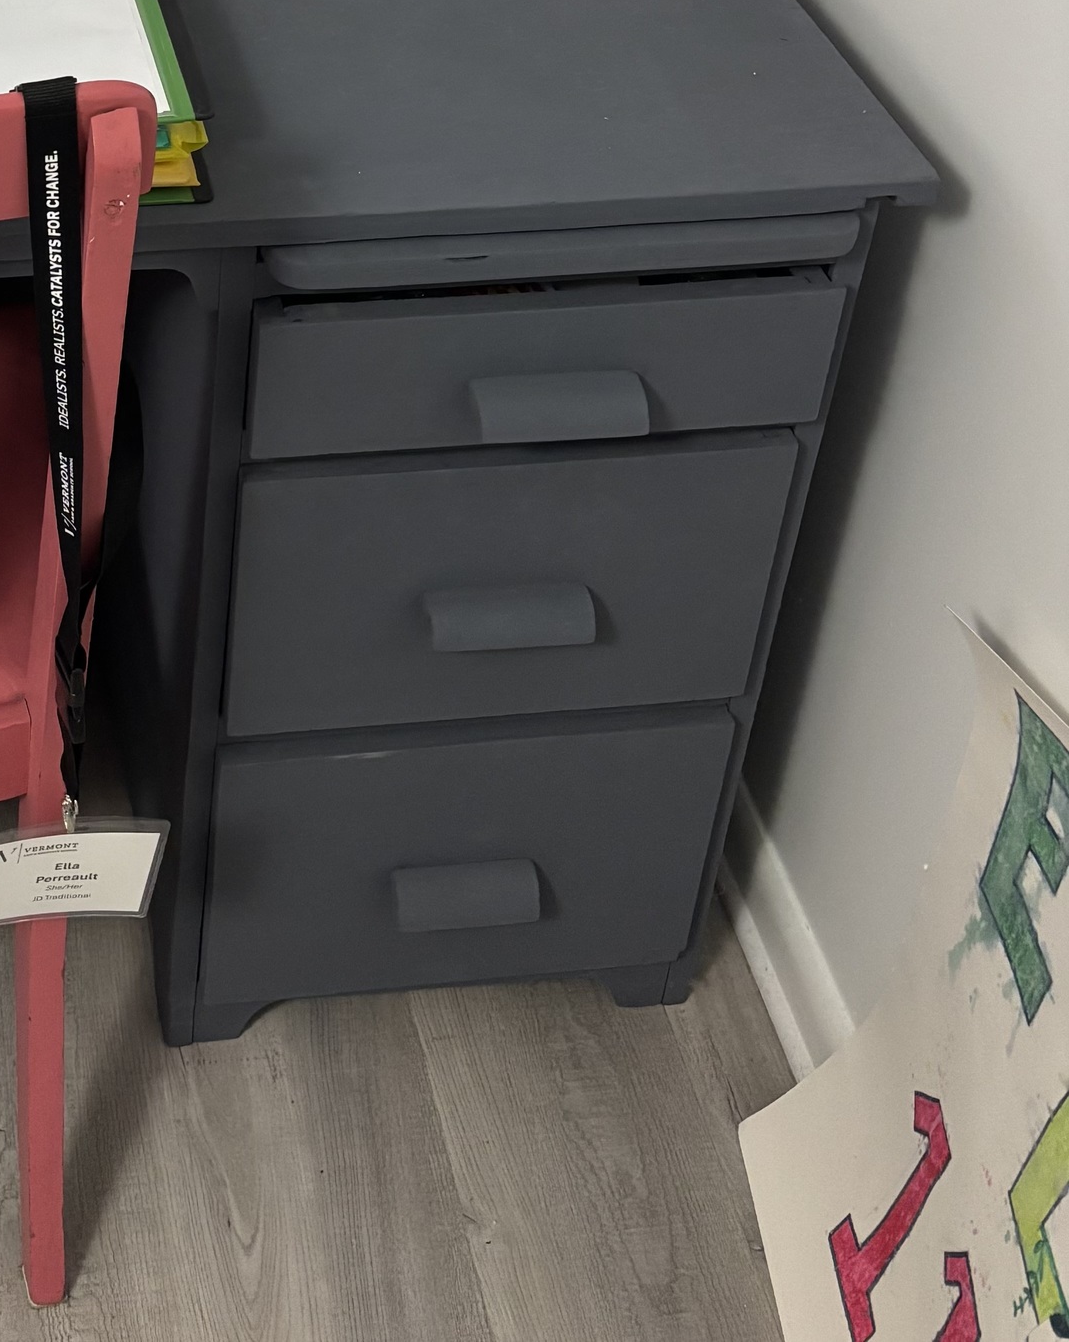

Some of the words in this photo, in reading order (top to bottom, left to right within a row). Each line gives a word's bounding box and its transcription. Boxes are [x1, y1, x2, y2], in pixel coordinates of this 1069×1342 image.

[44, 150, 60, 209] CHANGE.
[46, 212, 61, 237] FOR
[48, 239, 63, 307] CATALYSTS
[52, 308, 66, 365] REALISTS.
[55, 368, 70, 430] IDEALISTS.
[58, 452, 70, 514] VERMONT
[24, 842, 79, 853] VERMONT
[54, 862, 80, 871] Ella
[45, 892, 92, 901] Traditional
